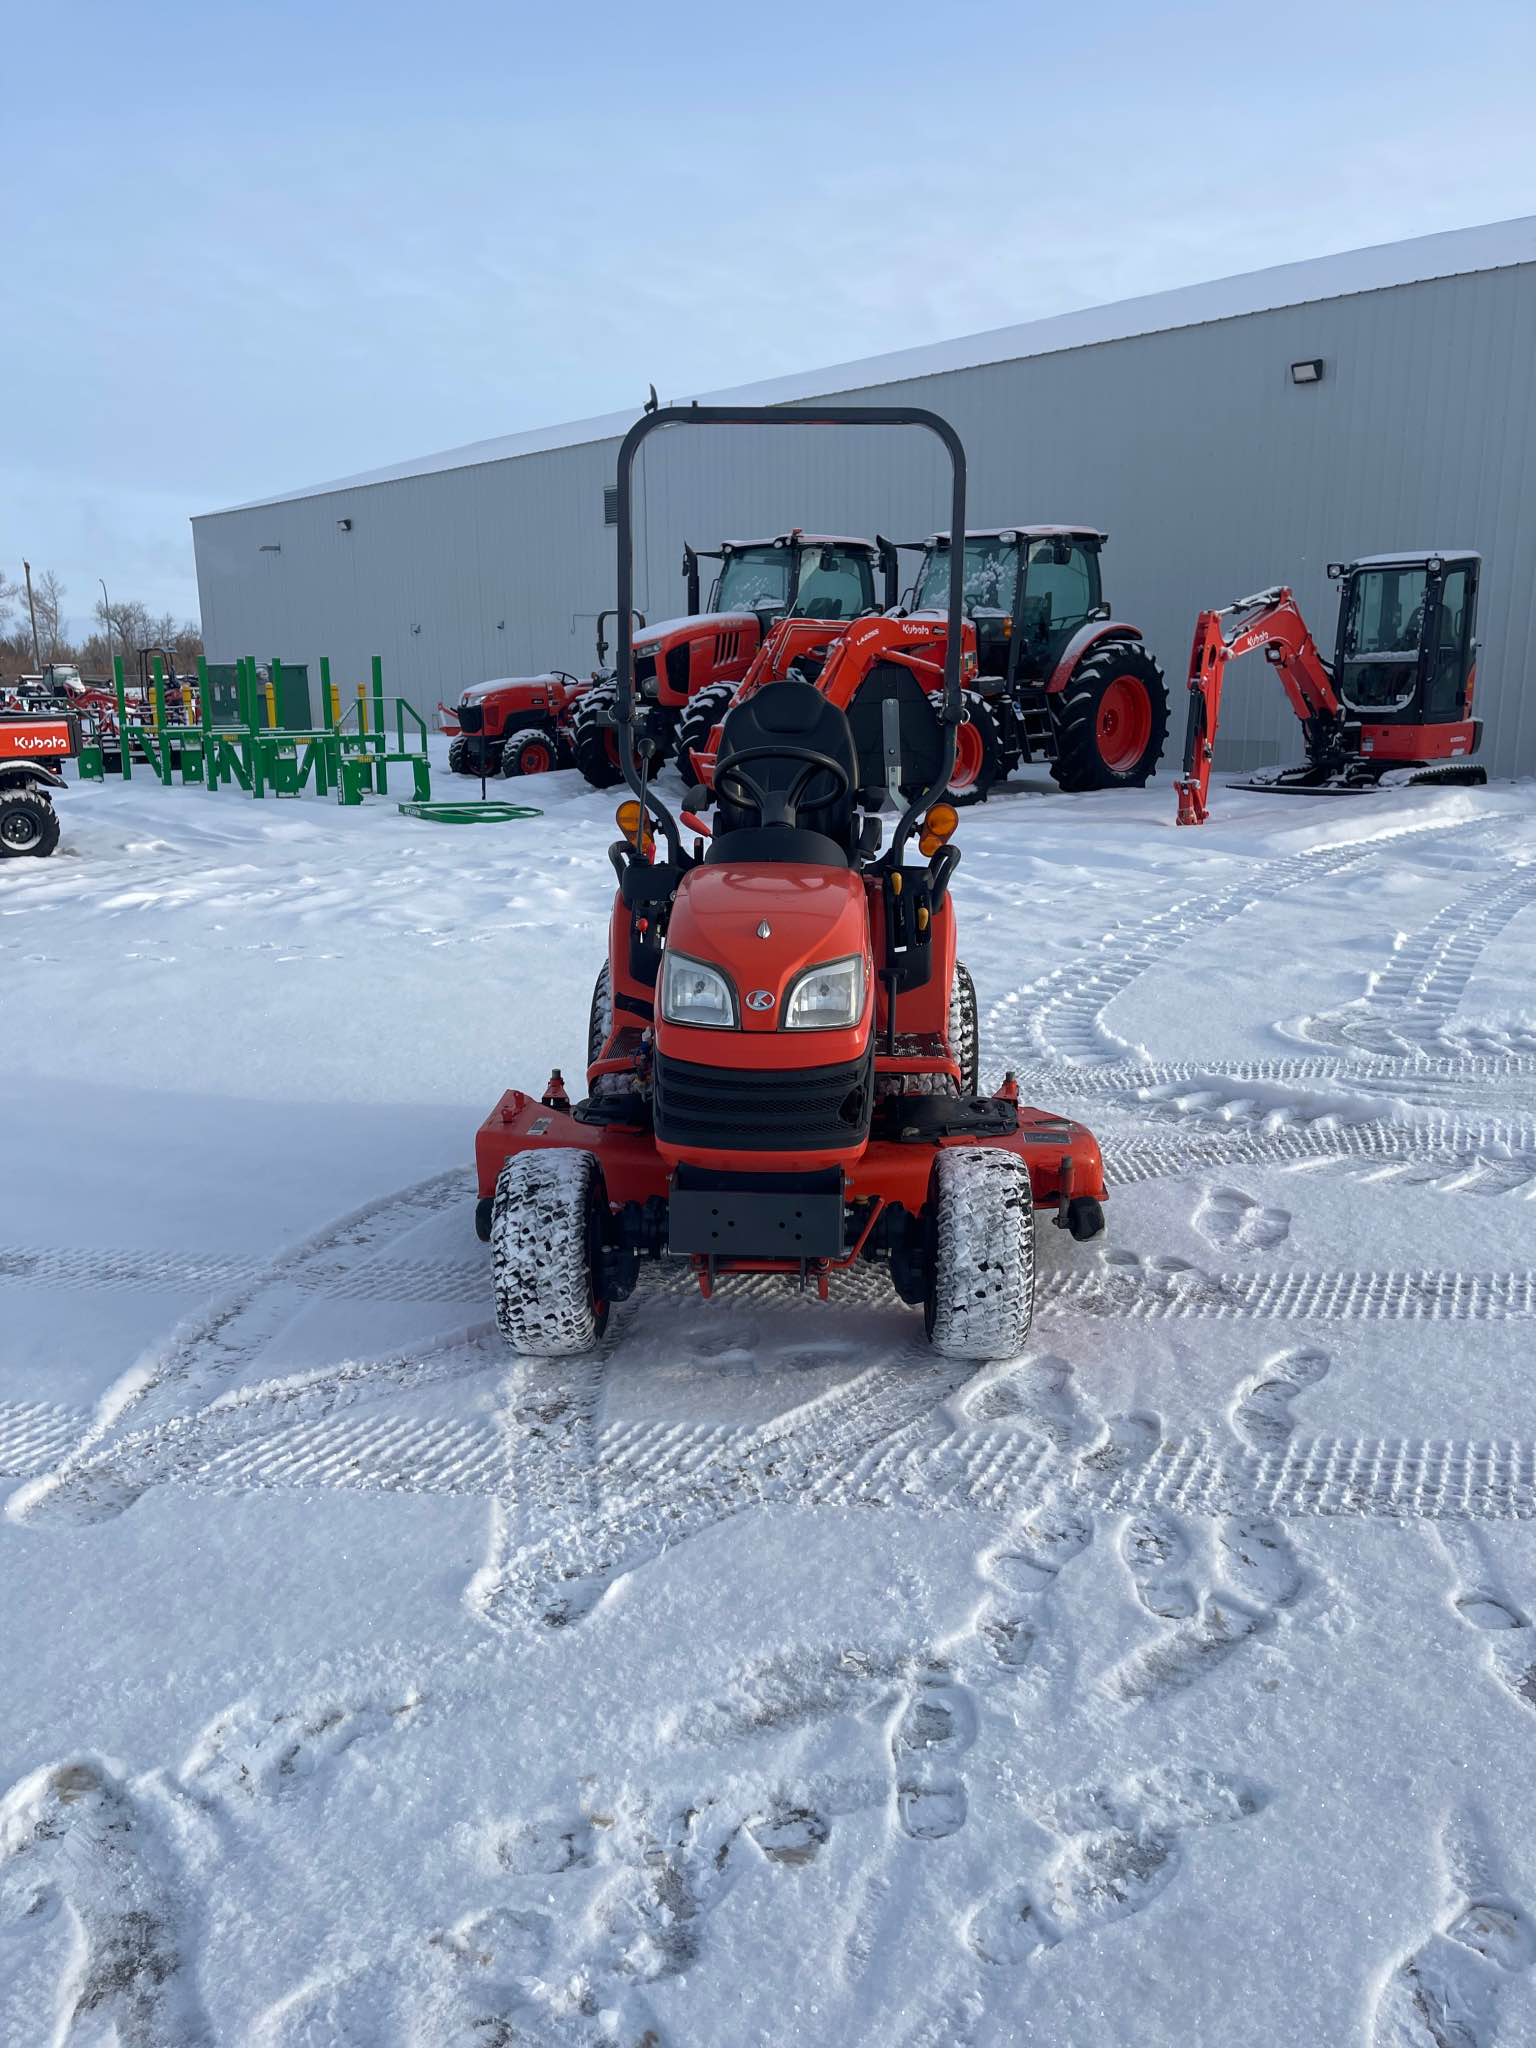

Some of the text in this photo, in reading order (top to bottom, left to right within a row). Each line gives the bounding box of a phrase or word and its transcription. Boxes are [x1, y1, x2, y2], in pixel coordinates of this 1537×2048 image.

[902, 623, 929, 635] Kubota
[1247, 631, 1269, 646] Kubota
[14, 736, 67, 749] Kubota
